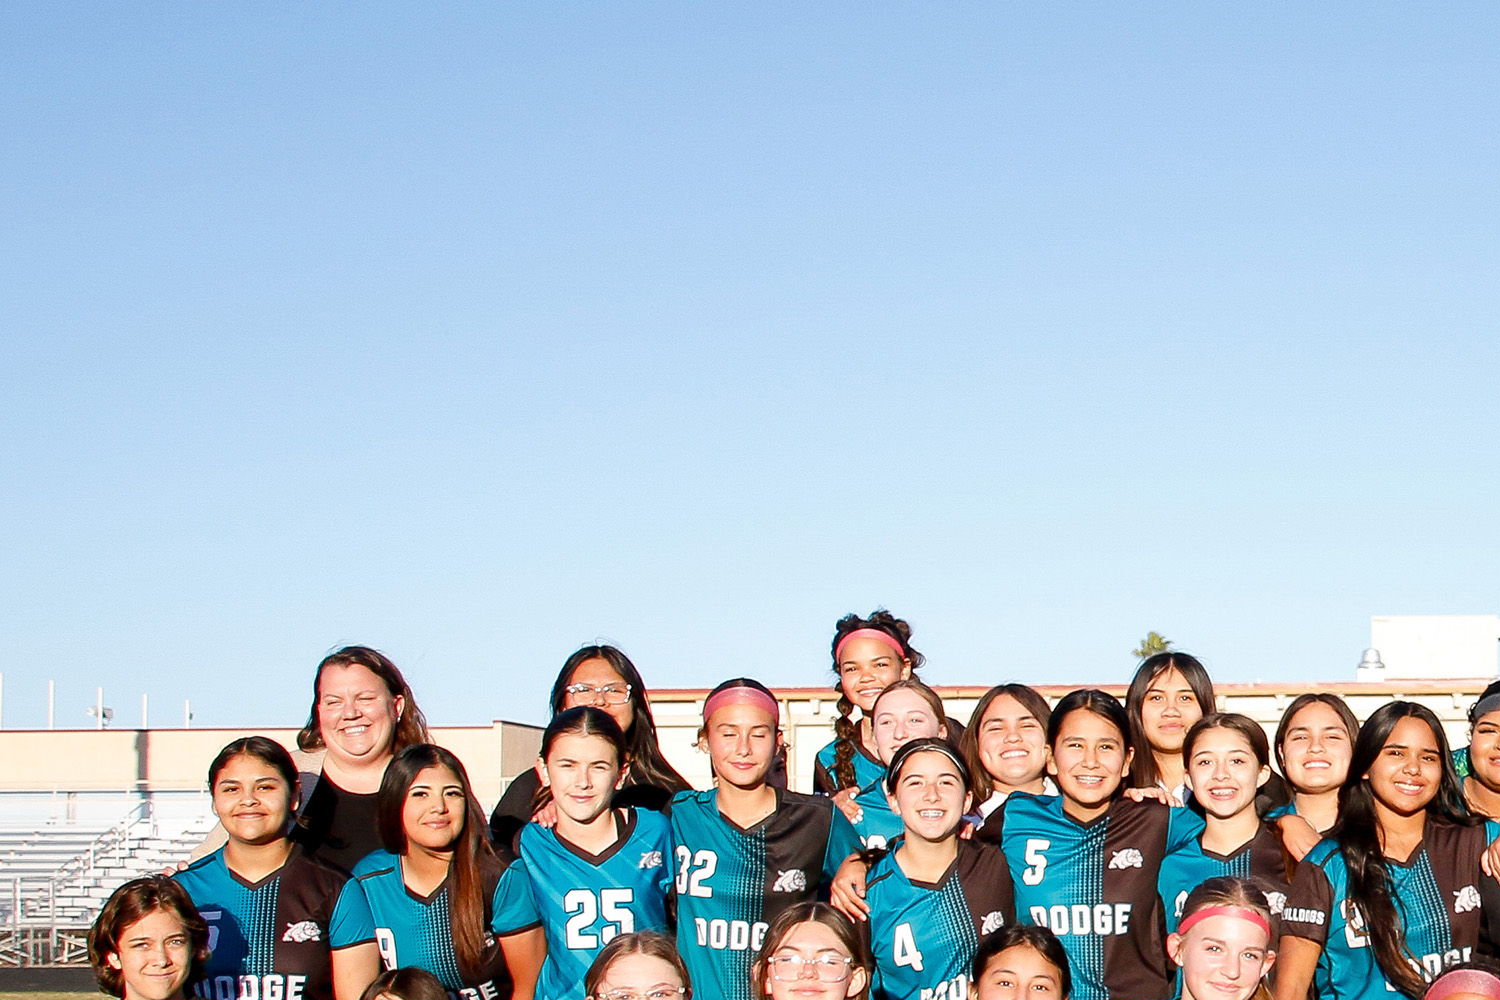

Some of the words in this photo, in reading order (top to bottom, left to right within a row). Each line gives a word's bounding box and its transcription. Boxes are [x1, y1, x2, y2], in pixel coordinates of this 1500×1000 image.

[676, 845, 718, 897] 32
[1022, 838, 1051, 886] 5
[564, 888, 635, 949] 25
[1029, 904, 1132, 936] DODGE
[894, 922, 924, 971] 4
